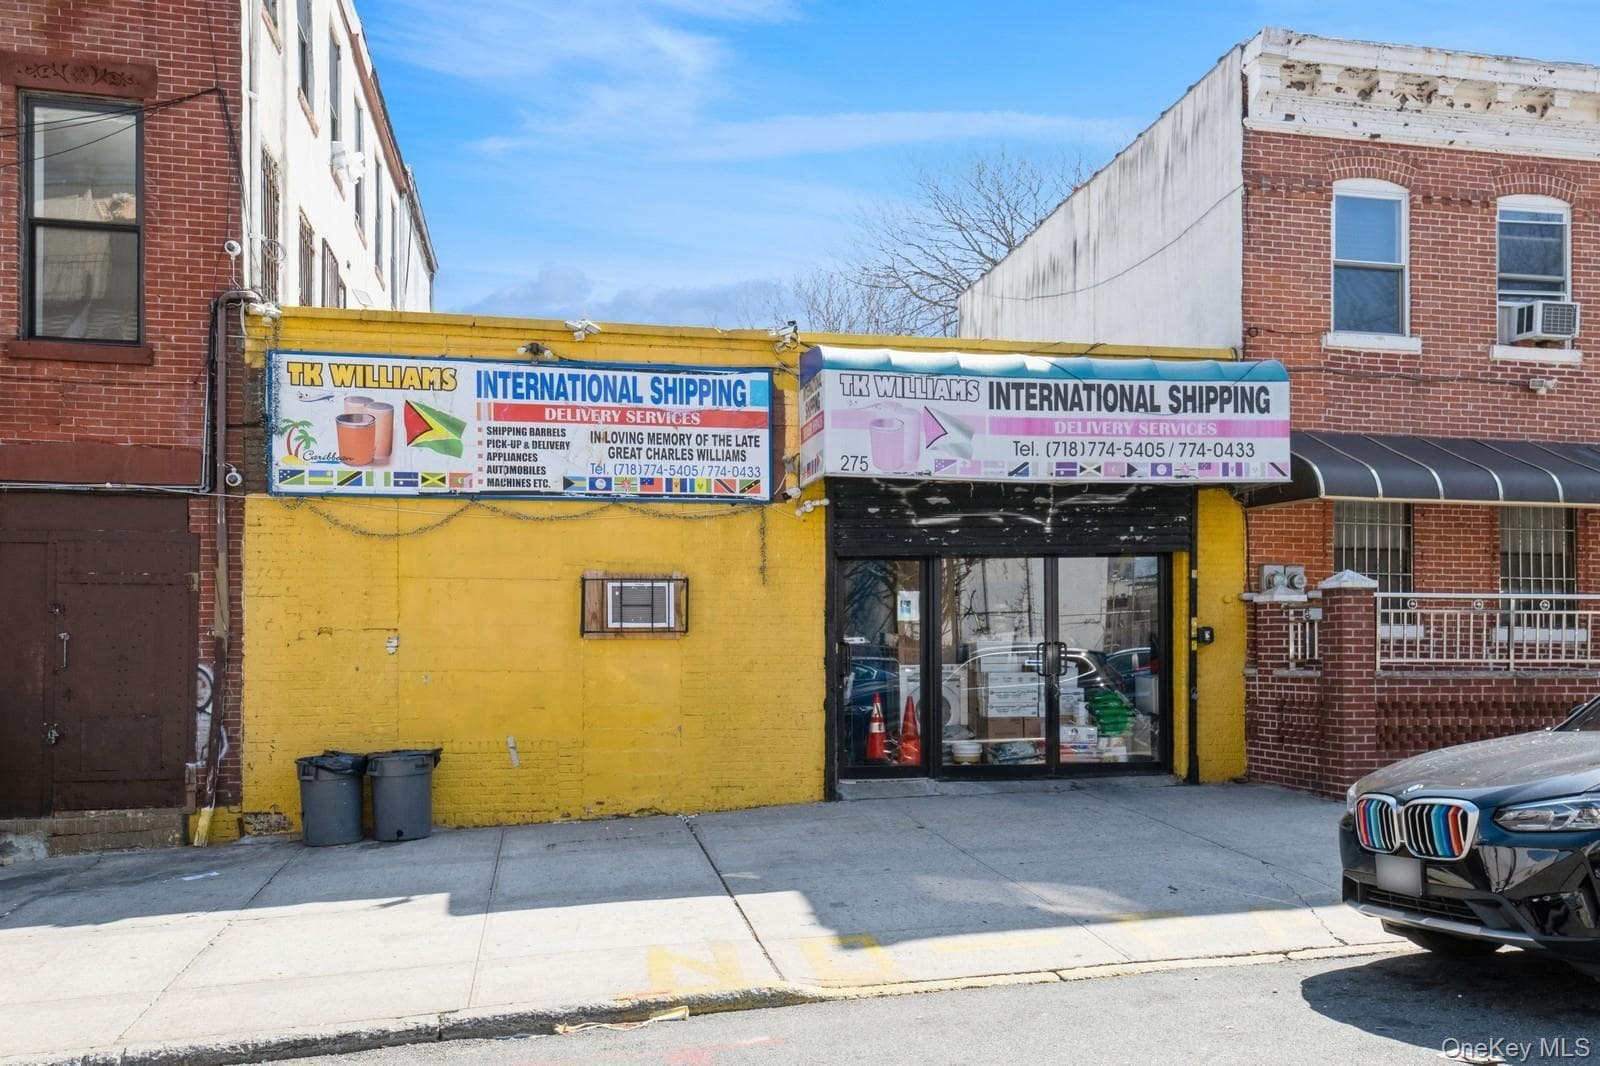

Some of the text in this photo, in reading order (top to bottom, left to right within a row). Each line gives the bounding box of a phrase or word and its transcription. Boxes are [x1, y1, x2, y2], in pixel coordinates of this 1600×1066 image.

[287, 362, 457, 391] TK WILLIAMS
[476, 370, 747, 407] INTERNATIONAL SHIPPING
[840, 374, 980, 402] TK WILLIAMS
[988, 381, 1270, 414] INTERNATIONAL SHIPPING
[545, 407, 701, 425] DELIVERY SERVICES
[486, 426, 567, 438] SHIPPING BARRELS
[1054, 420, 1217, 436] DELIVERY SERVICES
[486, 439, 570, 450] PICK-UP & DELIVERY
[590, 431, 760, 448] IN LOVING MEMORY OF THE LATE
[302, 450, 354, 463] Caribbean
[608, 446, 747, 462] GREAT CHARLES WILLIAMS
[1013, 440, 1039, 457] Tel.
[486, 452, 538, 462] APPLIANCES
[840, 455, 869, 471] 275
[486, 465, 547, 475] AUTOMOBILES
[590, 463, 609, 475] Tel.
[486, 477, 551, 489] MACHINES ETC.
